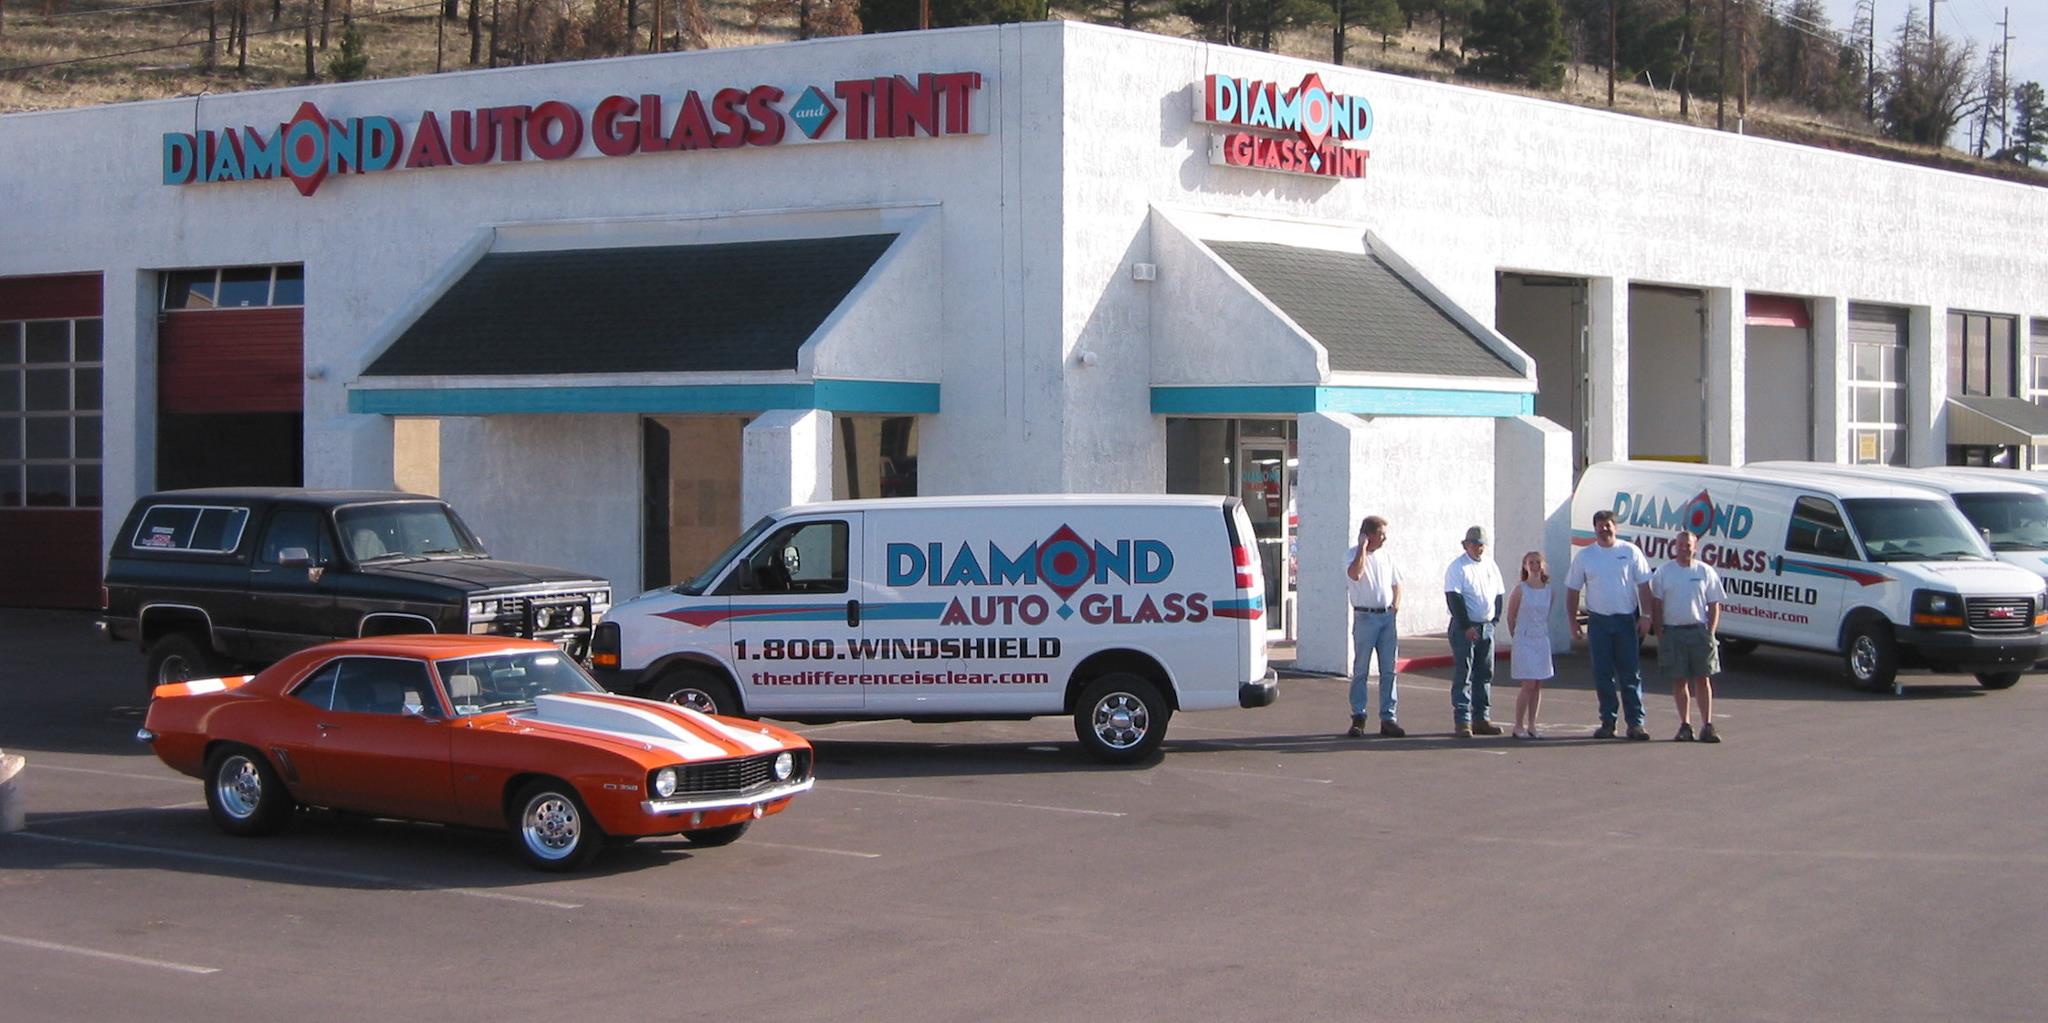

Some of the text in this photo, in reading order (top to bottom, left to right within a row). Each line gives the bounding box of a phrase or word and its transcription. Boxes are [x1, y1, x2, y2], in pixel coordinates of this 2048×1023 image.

[1207, 74, 1373, 141] DIAMOND
[163, 72, 981, 186] DIAMOND AUTO GLASS and TINT
[1226, 132, 1369, 179] GLASS TINT
[1612, 491, 1753, 540] DIAMOND
[887, 540, 1174, 587] DIAMOND
[1701, 543, 1767, 573] GLASS
[1721, 576, 1818, 606] INDSHIELD
[939, 592, 1209, 626] AUTO GLASS
[1719, 602, 1809, 625] nceisclear.com
[733, 637, 1062, 660] 1.800.WINDSHIELD
[751, 670, 1049, 686] thedifferenceisclear.com
